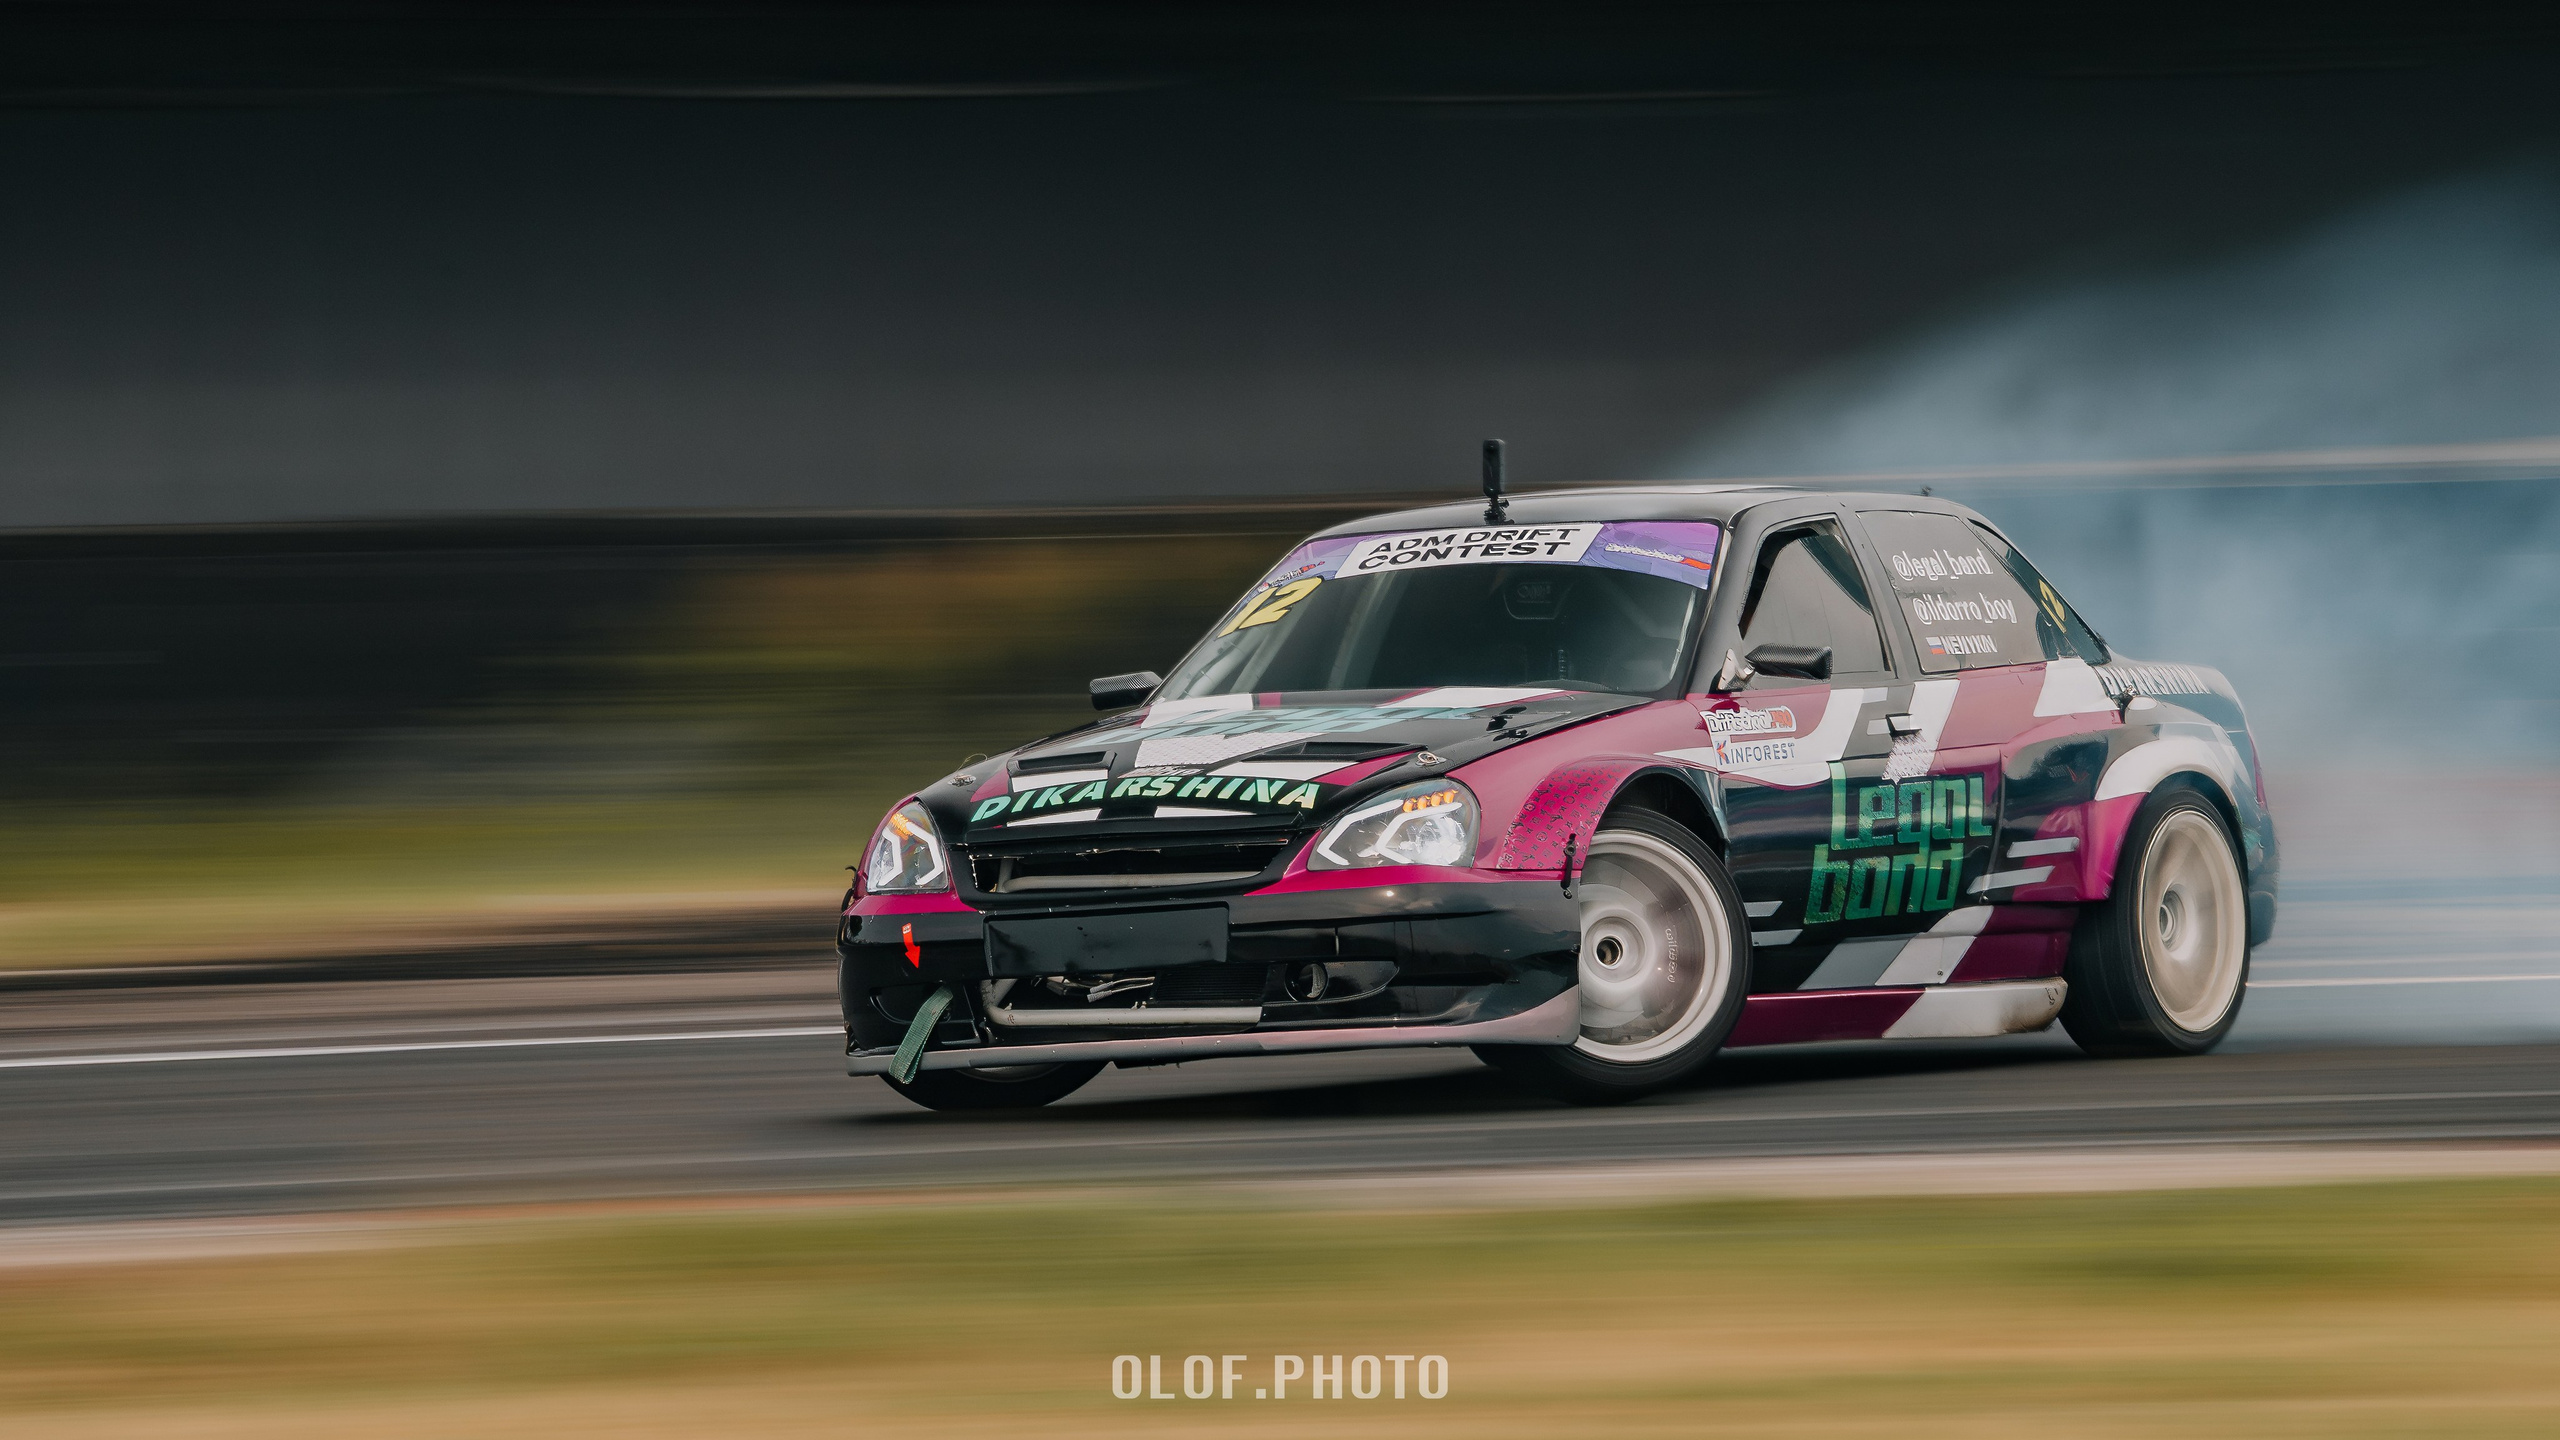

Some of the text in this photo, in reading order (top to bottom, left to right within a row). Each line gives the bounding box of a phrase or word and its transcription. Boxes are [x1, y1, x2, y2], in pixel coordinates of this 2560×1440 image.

[1358, 540, 1572, 570] CONTEST
[1368, 527, 1581, 556] ADM DRIFT
[1217, 576, 1323, 638] 12
[970, 776, 1321, 823] DIKARSHINA
[1804, 842, 1965, 925] bond
